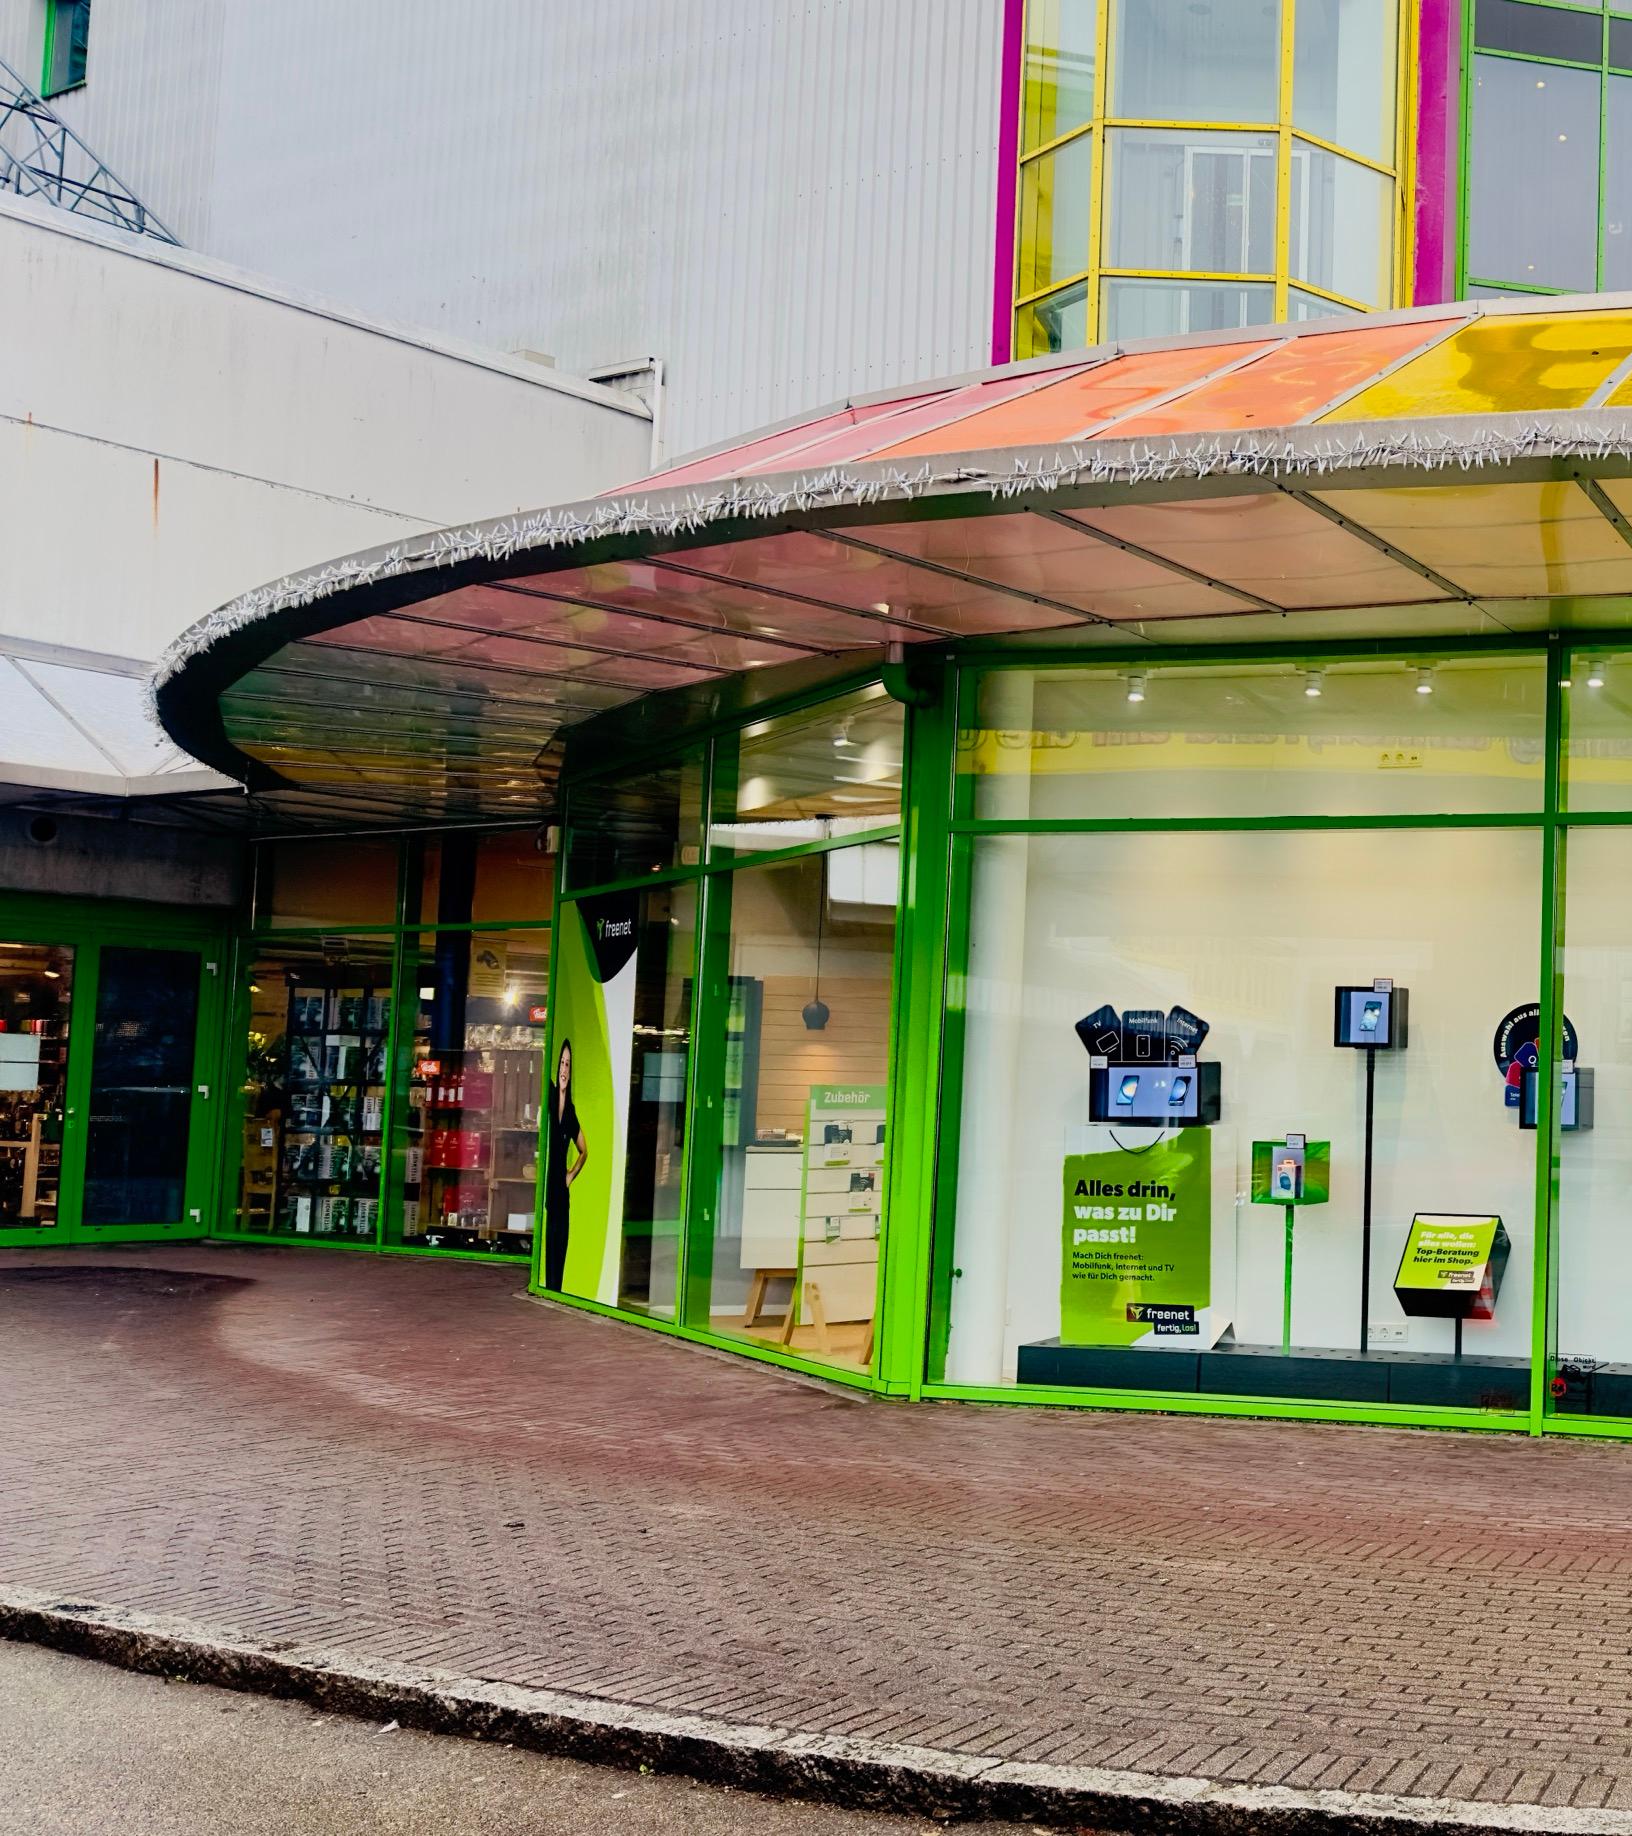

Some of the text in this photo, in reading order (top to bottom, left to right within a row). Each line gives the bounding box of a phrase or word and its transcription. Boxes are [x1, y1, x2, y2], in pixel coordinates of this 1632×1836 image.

[605, 918, 632, 938] freenet
[1093, 1020, 1102, 1029] TV
[1176, 1017, 1198, 1034] Internet
[824, 1091, 871, 1104] Zubehör
[1074, 1179, 1176, 1201] Alles drin,
[1073, 1203, 1177, 1222] was zu Dir
[1073, 1226, 1137, 1246] passt!
[1420, 1230, 1436, 1239] Für
[1459, 1232, 1475, 1240] die
[1072, 1251, 1144, 1261] Mach Dich freenet:
[1416, 1248, 1480, 1258] Top-Beratung
[1072, 1262, 1114, 1271] Mobilfunk,
[1115, 1263, 1147, 1271] Internet
[1148, 1264, 1163, 1272] und
[1447, 1257, 1474, 1266] Shop.
[1087, 1272, 1099, 1280] für
[1119, 1273, 1155, 1282] gemacht.
[1147, 1307, 1190, 1321] freenet
